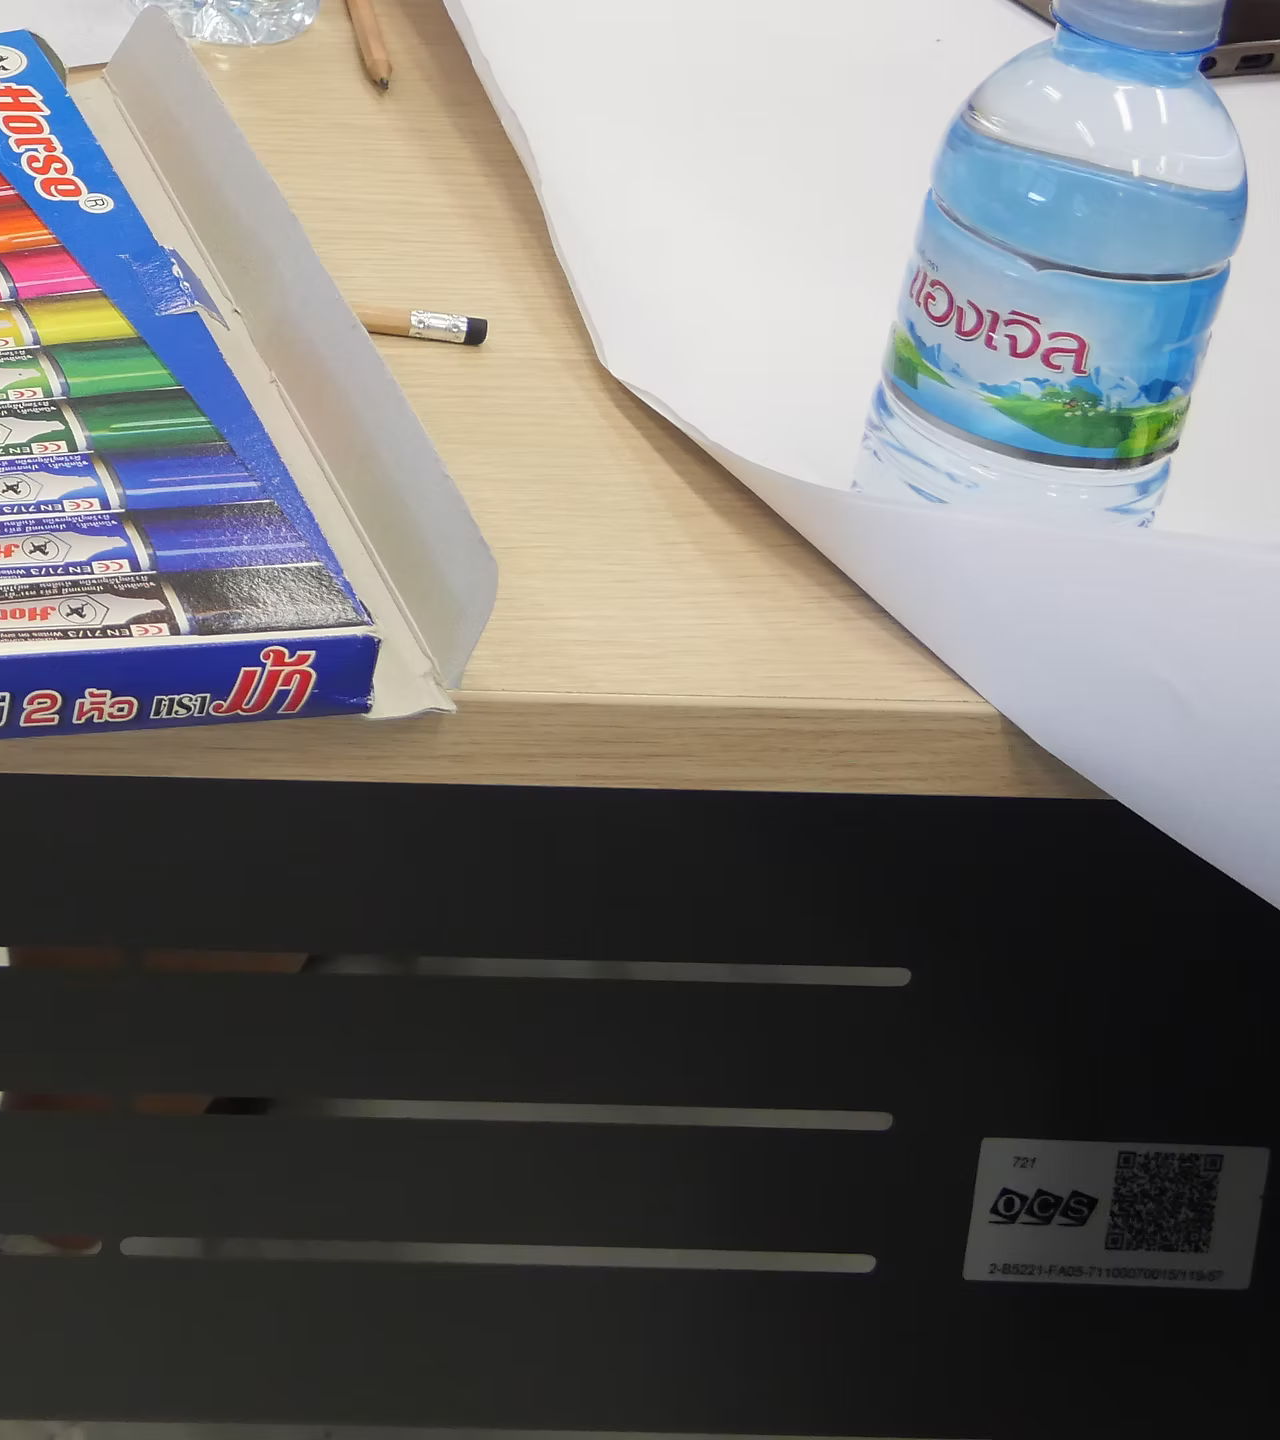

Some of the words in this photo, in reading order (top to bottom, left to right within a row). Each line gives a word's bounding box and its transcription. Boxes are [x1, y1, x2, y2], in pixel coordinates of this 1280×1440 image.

[909, 266, 1090, 377] แองเจิล
[20, 689, 62, 727] 2
[72, 688, 138, 724] หัว
[150, 692, 211, 719] ตรา
[209, 645, 317, 717] ม้า
[992, 1188, 1096, 1222] OCS
